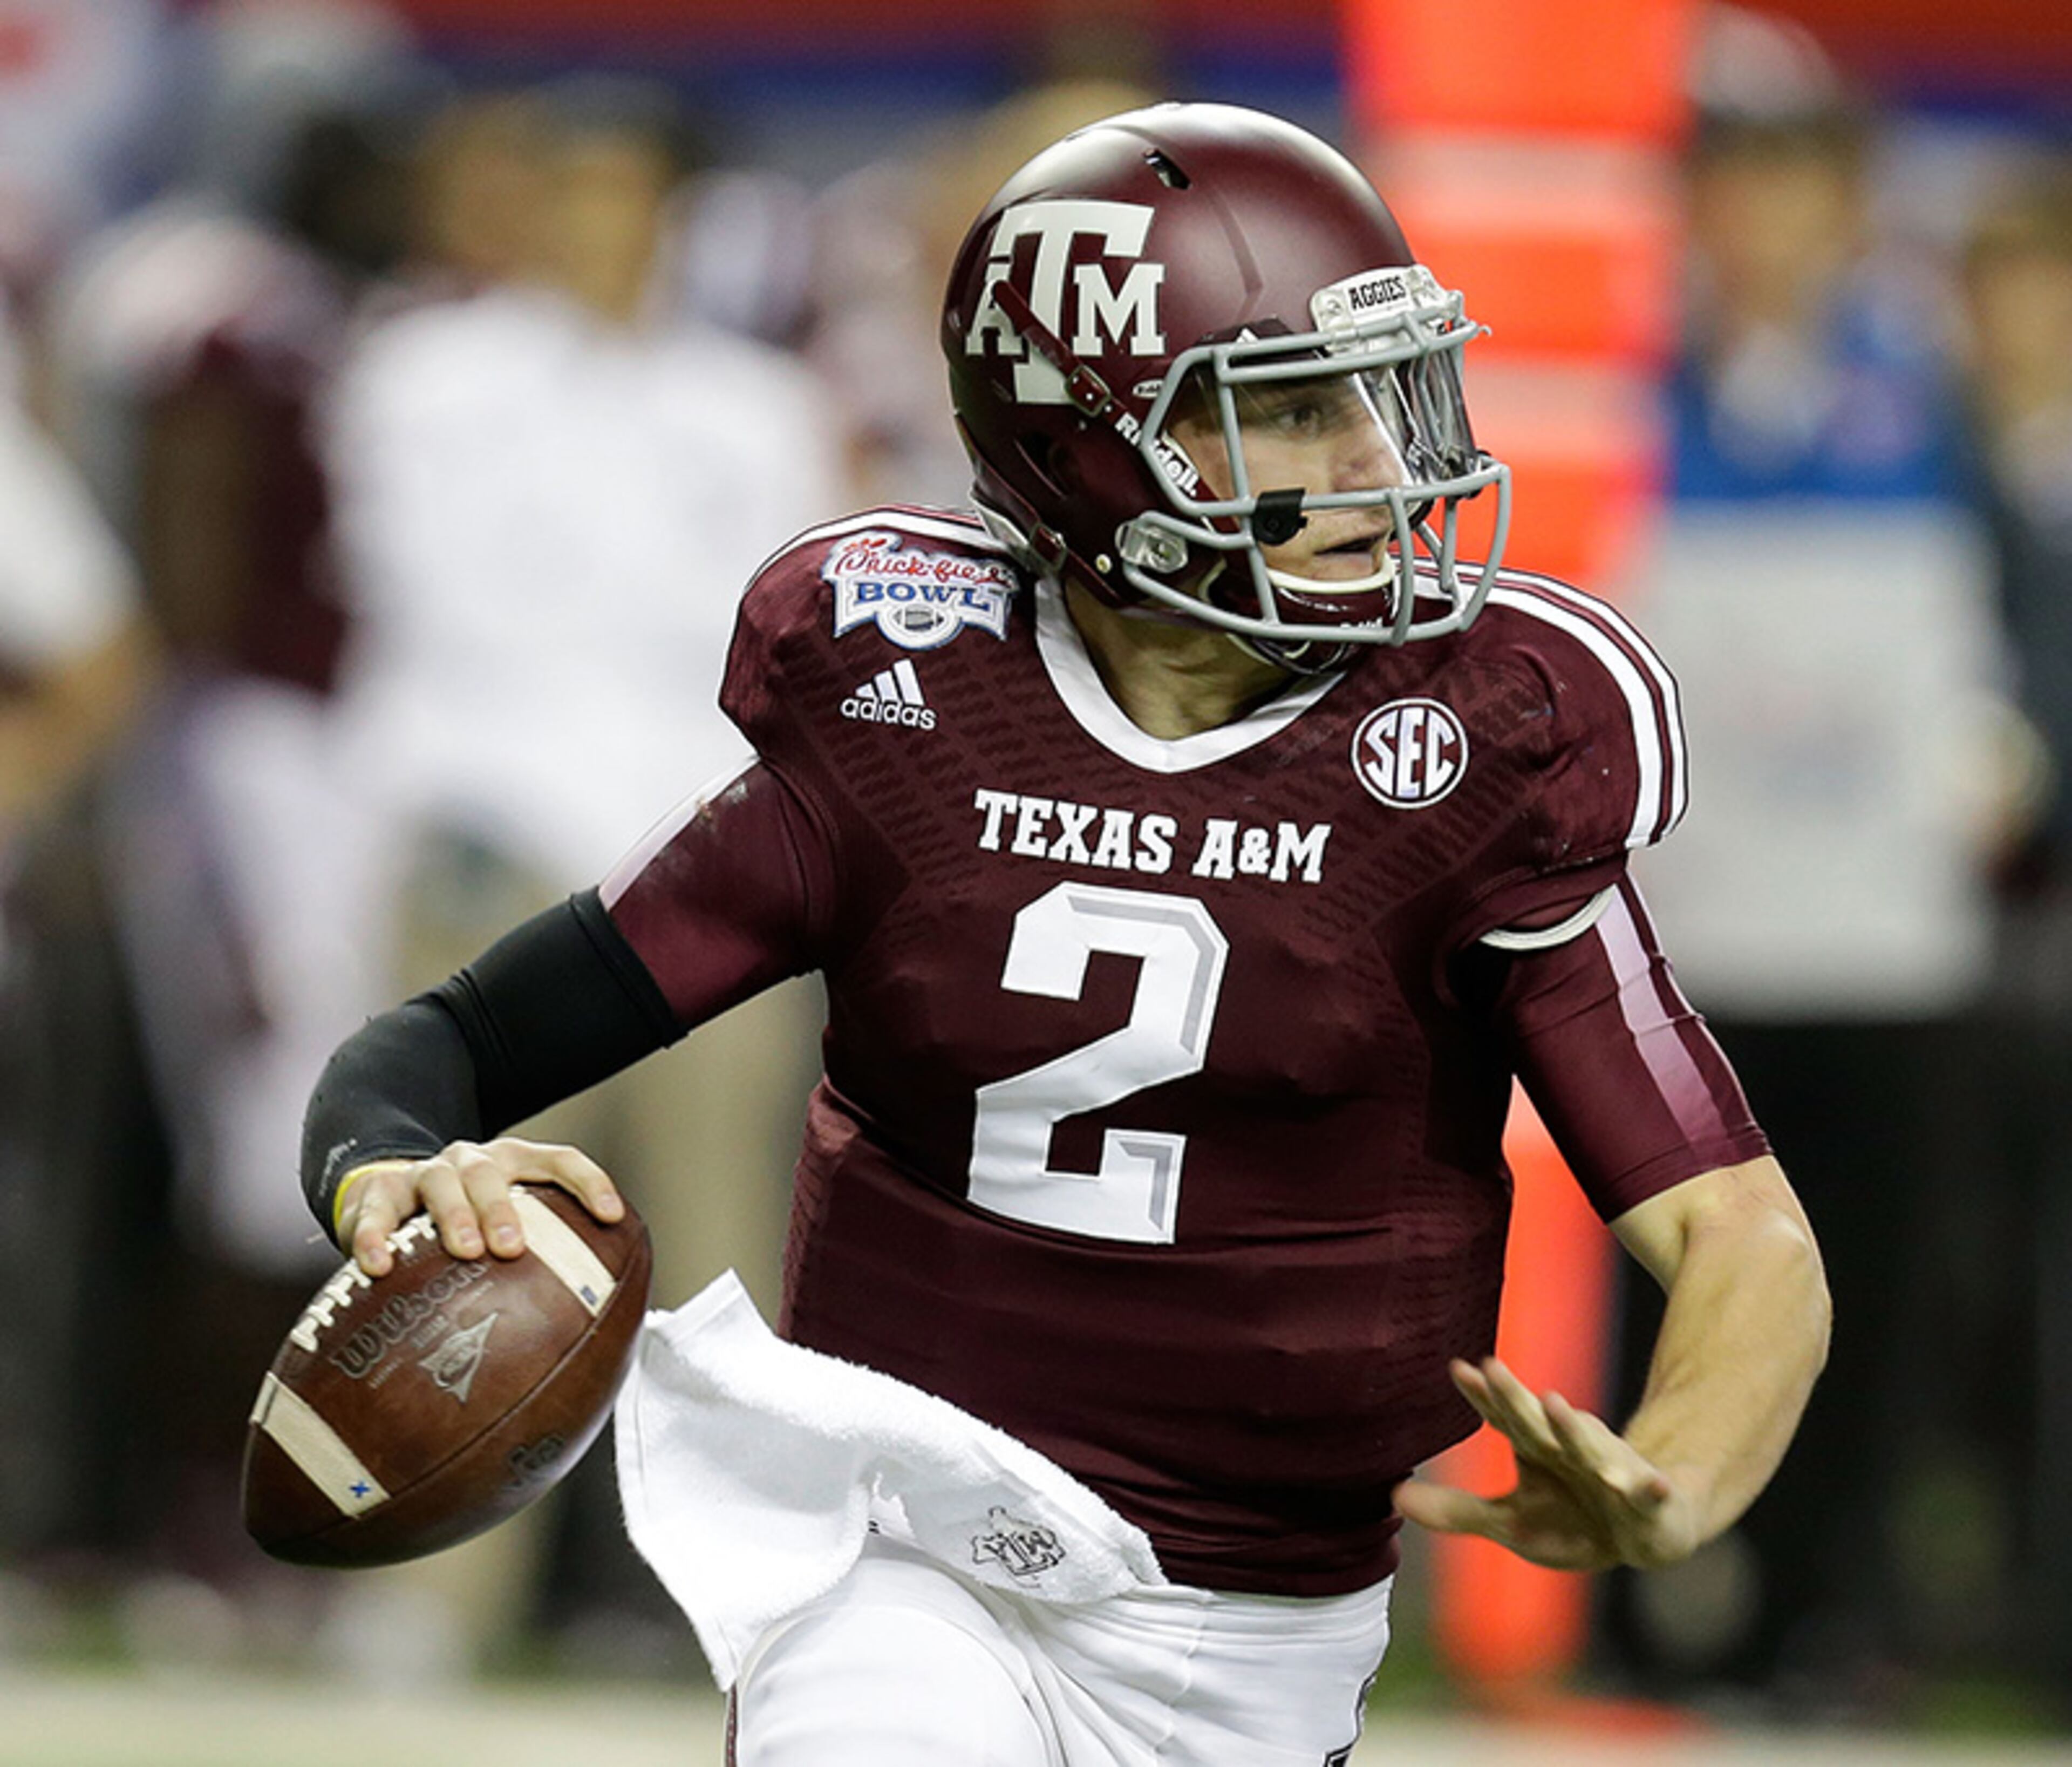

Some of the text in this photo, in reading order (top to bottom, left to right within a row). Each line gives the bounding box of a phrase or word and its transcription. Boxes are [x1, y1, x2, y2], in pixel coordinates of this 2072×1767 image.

[1348, 276, 1407, 310] AGGIES
[853, 582, 991, 611] BOWL
[840, 698, 937, 730] adidas
[1364, 706, 1456, 798] SEC
[974, 788, 1332, 884] TEXAS A&M
[966, 881, 1230, 1244] 2
